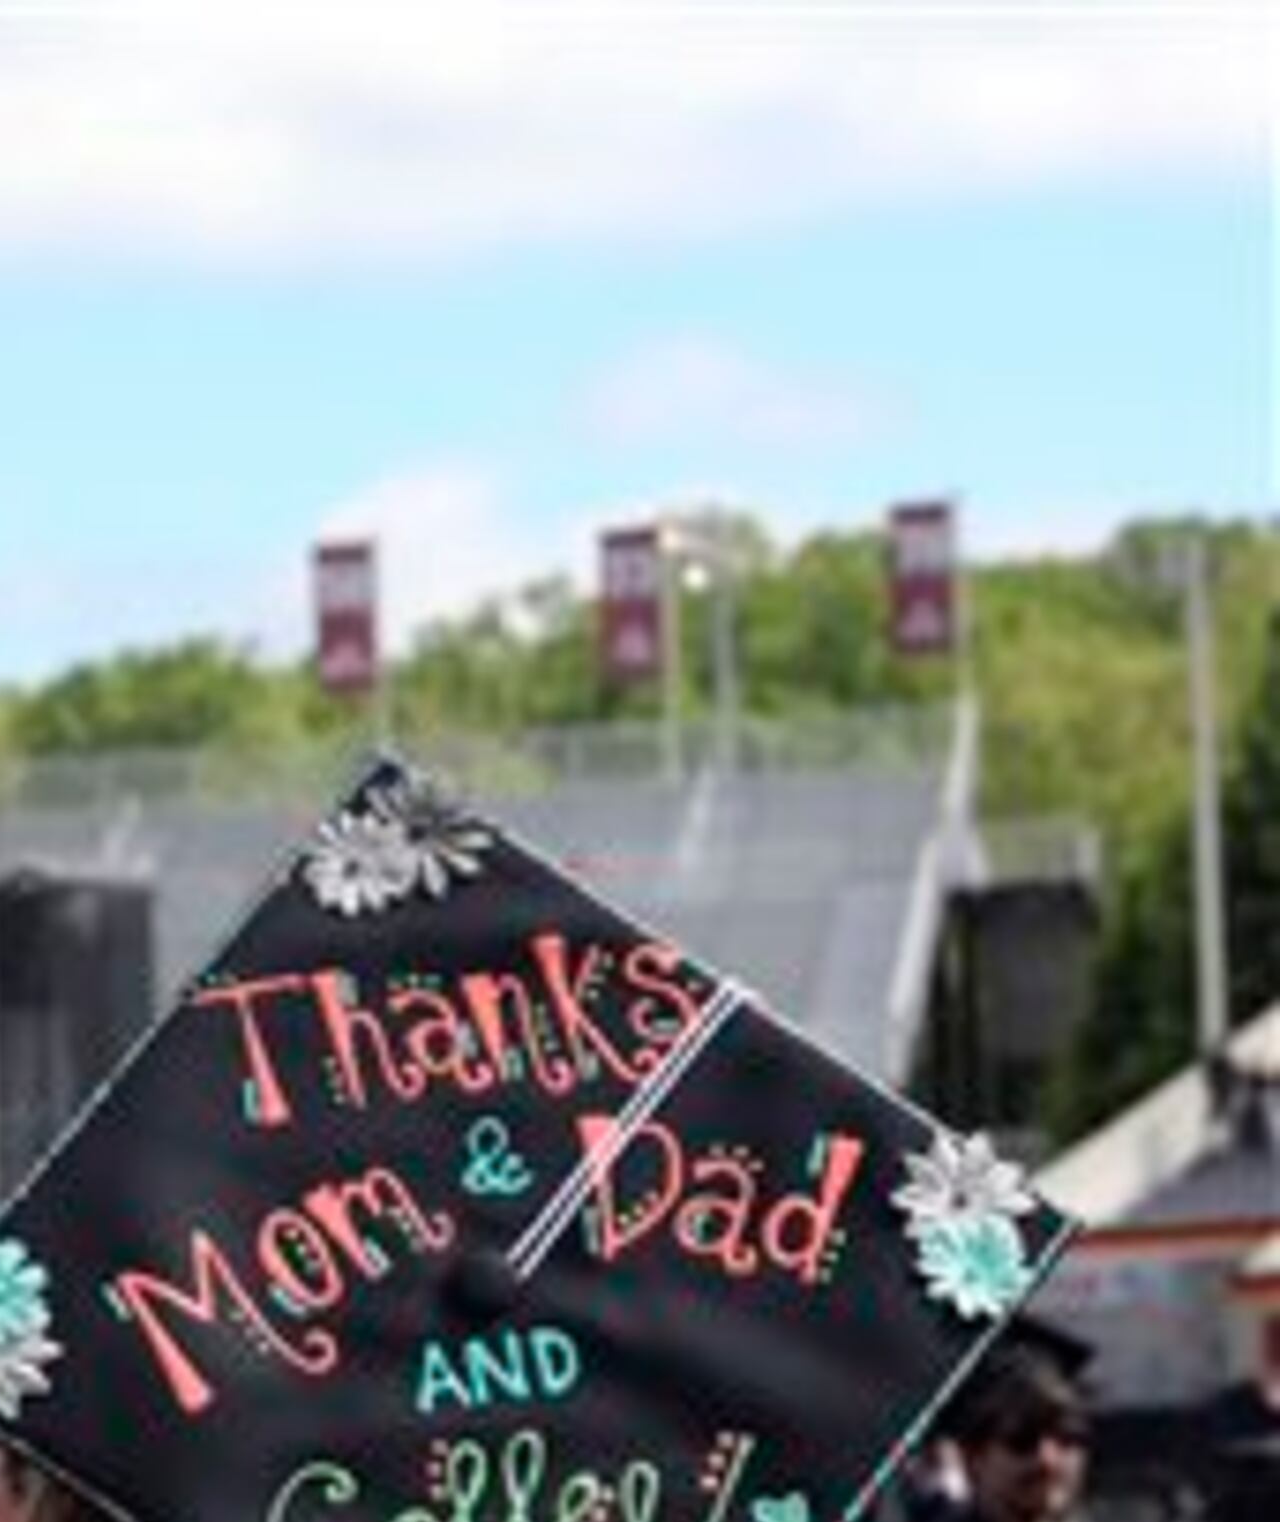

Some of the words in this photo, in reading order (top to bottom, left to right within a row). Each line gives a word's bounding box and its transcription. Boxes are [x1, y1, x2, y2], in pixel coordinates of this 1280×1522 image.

[192, 932, 722, 1128] Thanks
[104, 1163, 456, 1415] Mom
[461, 1115, 532, 1196] &
[575, 1112, 866, 1286] Dad
[414, 1325, 581, 1414] AND
